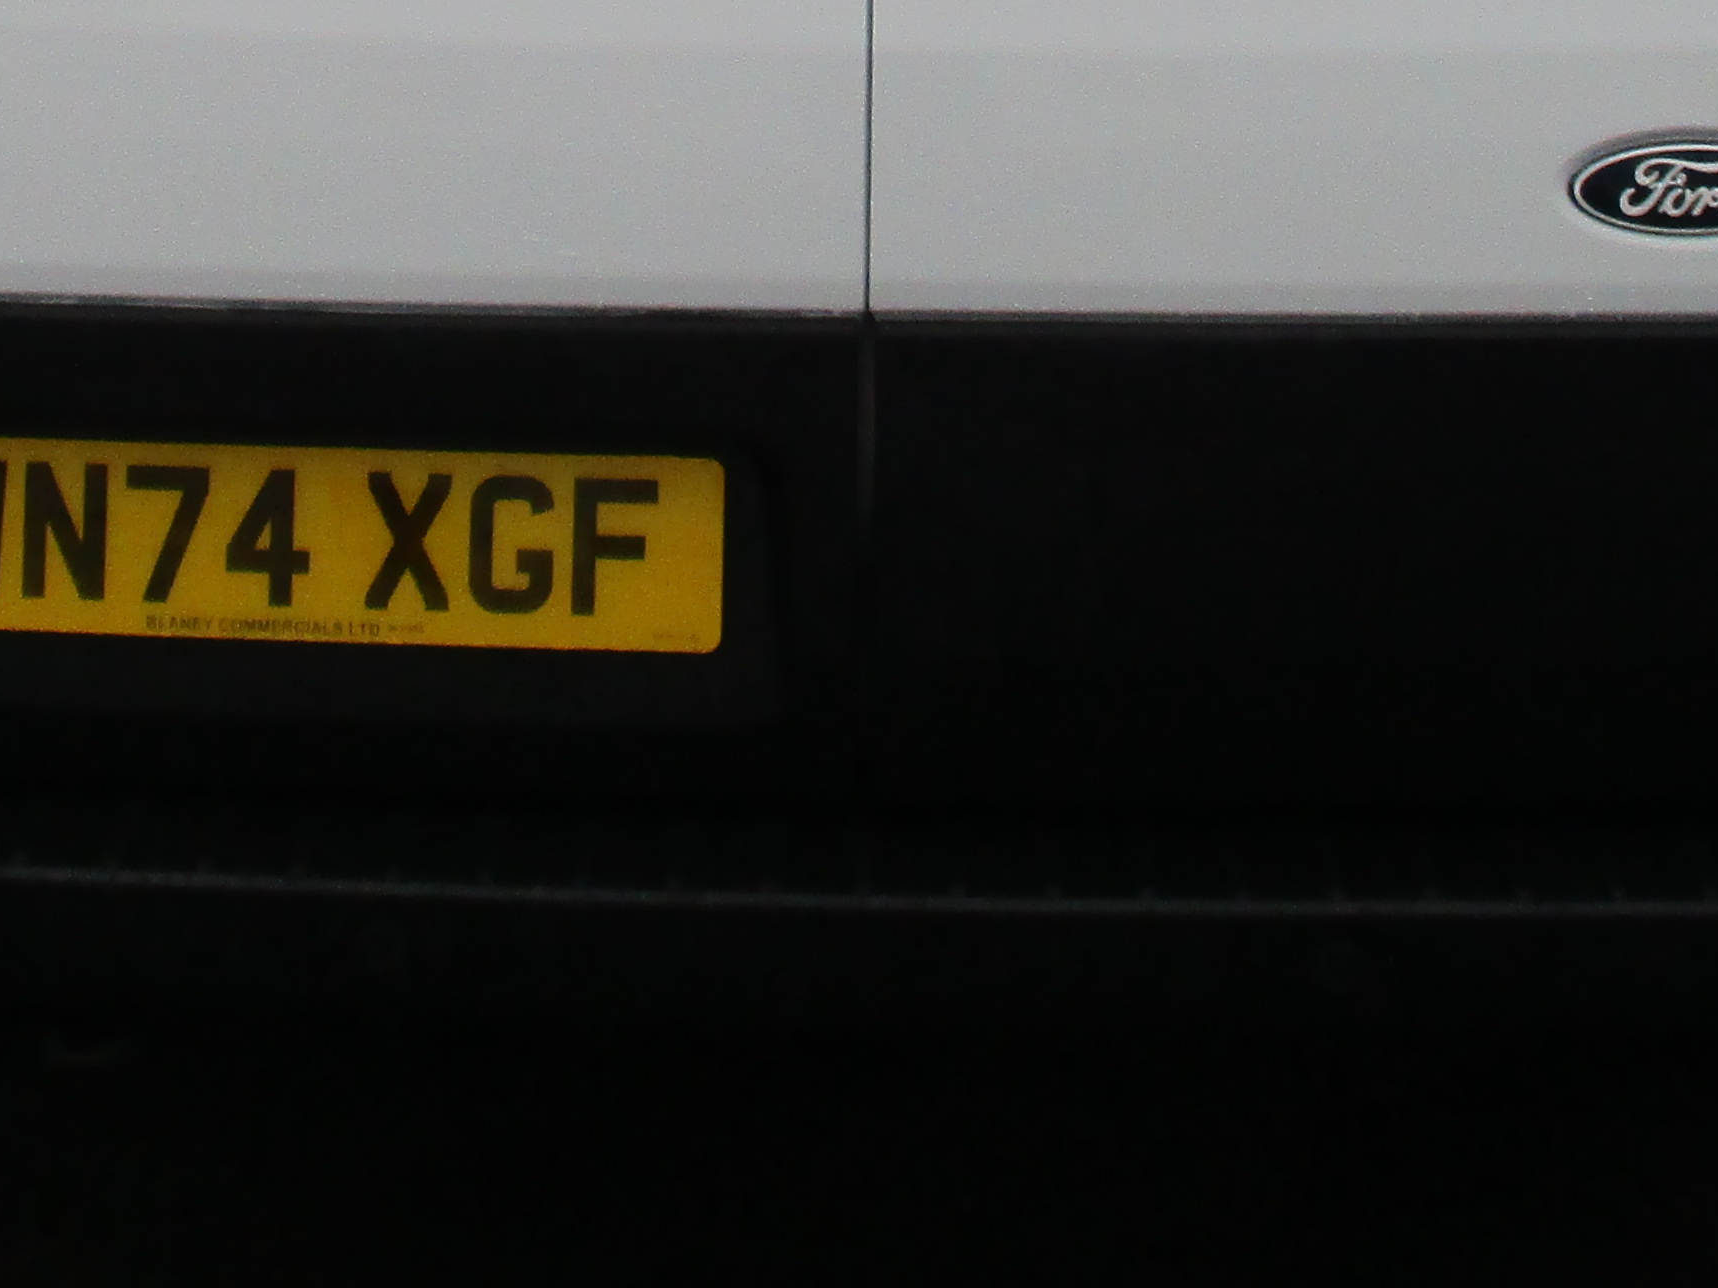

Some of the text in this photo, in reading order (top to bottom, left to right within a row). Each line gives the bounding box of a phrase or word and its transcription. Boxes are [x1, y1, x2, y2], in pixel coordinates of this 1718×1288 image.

[363, 470, 659, 617] XGF
[218, 618, 343, 636] COMMERCIALS
[348, 622, 380, 637] LTD
